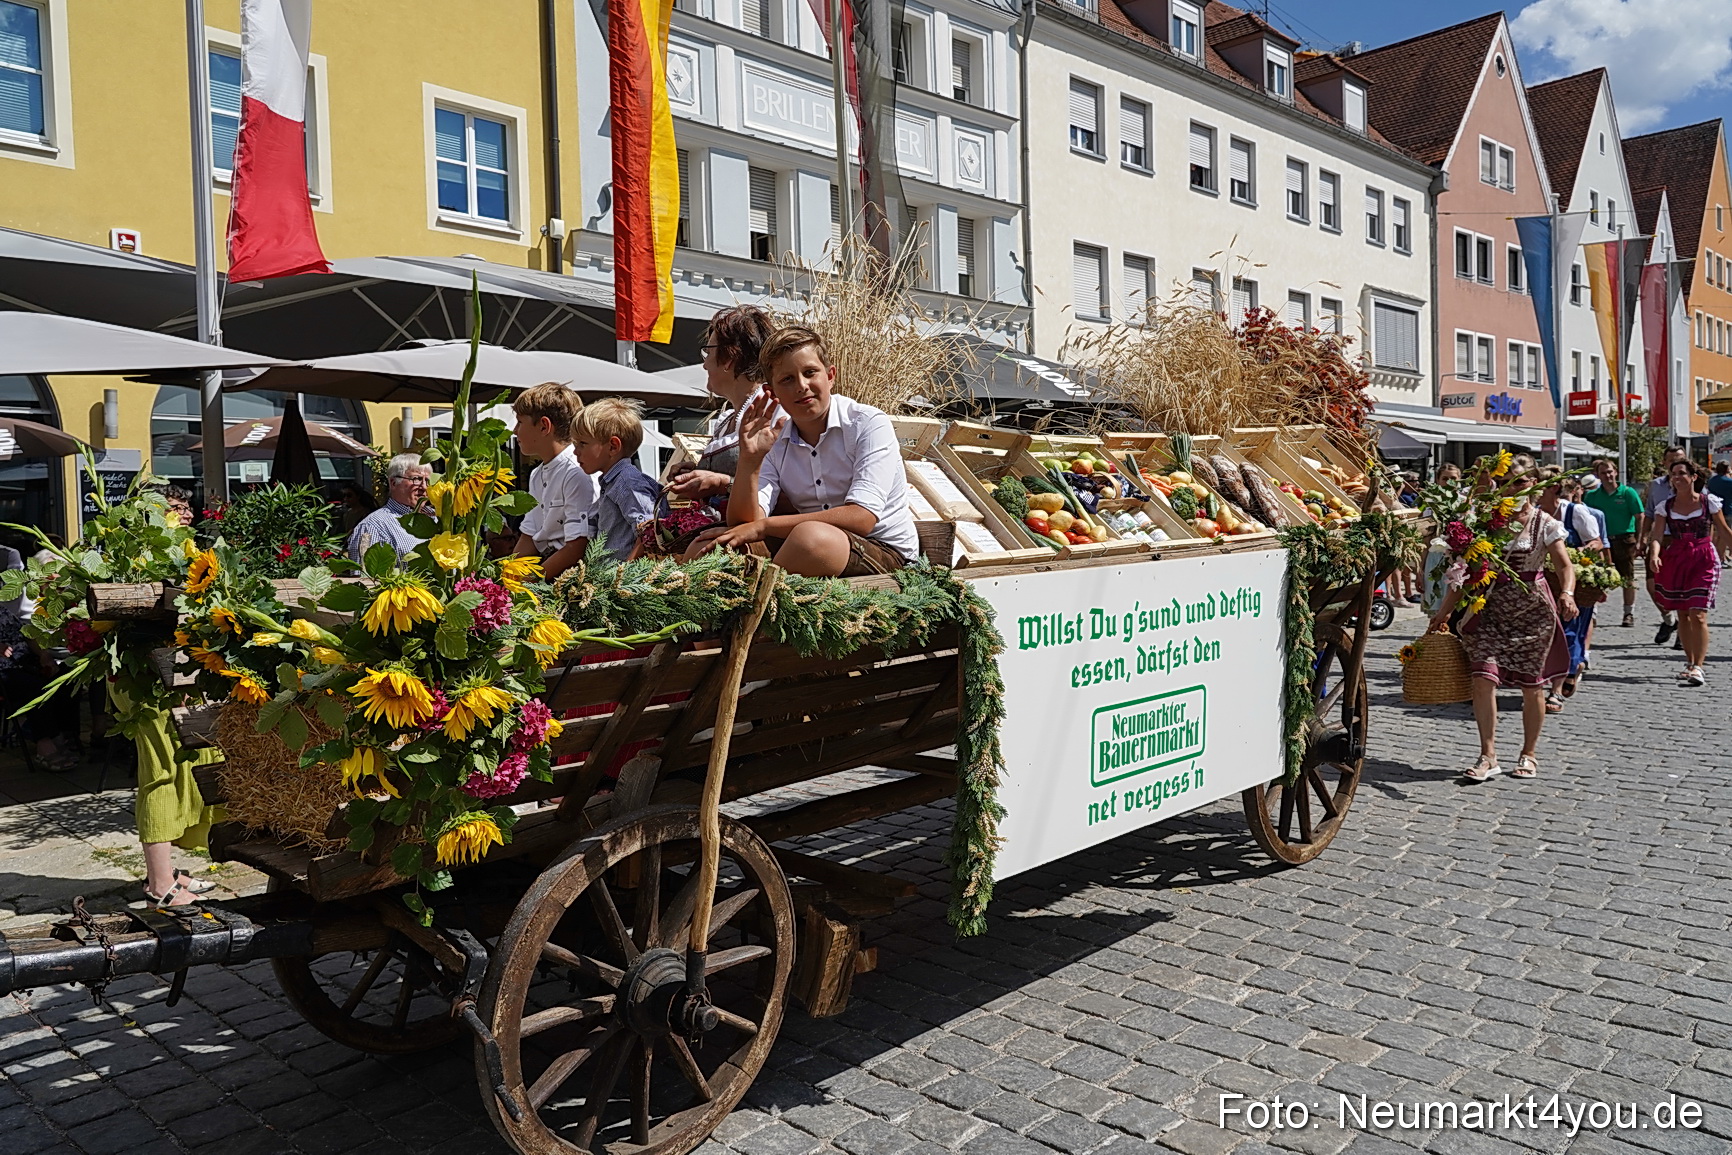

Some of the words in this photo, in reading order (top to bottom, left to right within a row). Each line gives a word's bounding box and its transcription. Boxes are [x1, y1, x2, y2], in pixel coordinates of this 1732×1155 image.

[1018, 612, 1083, 650] Willst
[1088, 607, 1117, 640] Du
[1123, 598, 1182, 643] g'sund
[1185, 593, 1216, 624] und
[1220, 587, 1262, 620] deftig
[1071, 658, 1131, 688] essen,
[1136, 640, 1189, 675] därfst
[1193, 637, 1221, 664] den
[1099, 719, 1200, 773] Bauernmarkt
[1111, 702, 1187, 741] Neumarkter
[1088, 792, 1117, 826] net
[1124, 760, 1204, 811] vergess'n
